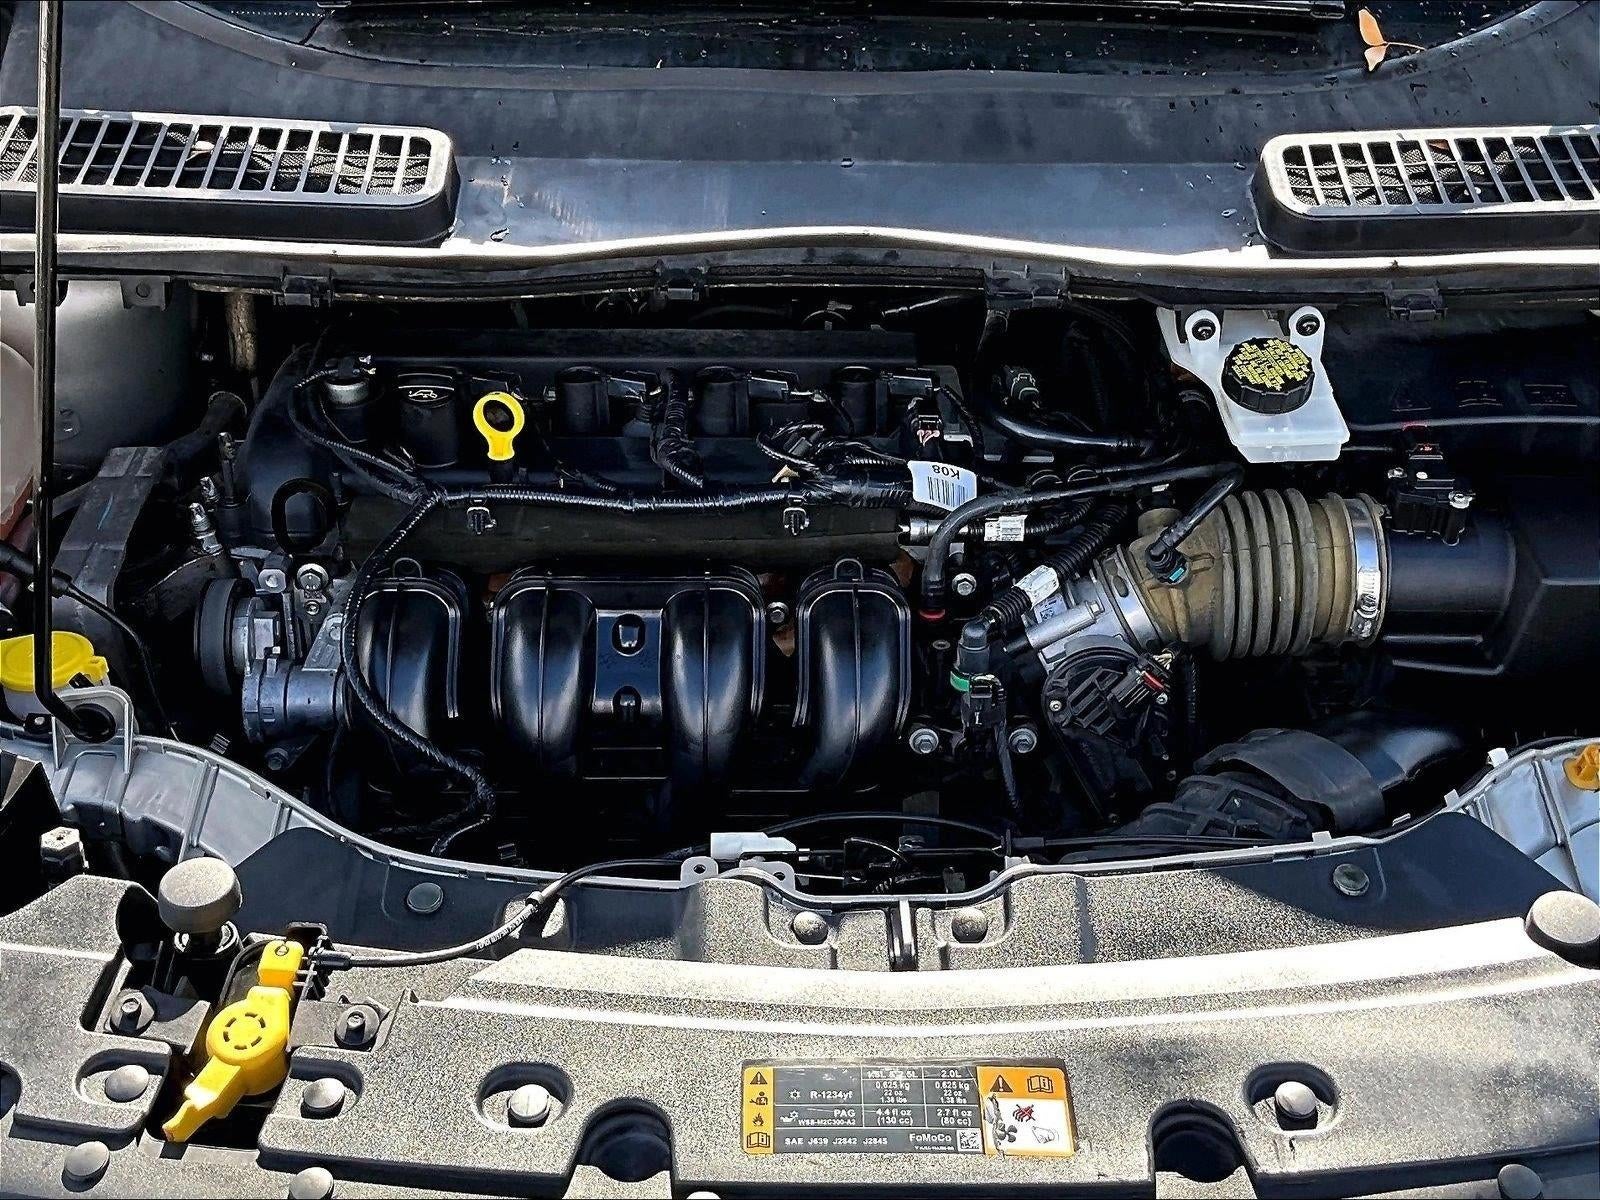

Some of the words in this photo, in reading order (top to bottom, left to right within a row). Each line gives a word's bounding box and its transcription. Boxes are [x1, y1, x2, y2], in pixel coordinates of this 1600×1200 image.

[932, 465, 960, 480] K08
[941, 1070, 962, 1078] 2.0L
[875, 1081, 897, 1089] 0.625
[900, 1081, 911, 1091] kg
[935, 1081, 957, 1089] 0.625
[959, 1081, 970, 1091] kg
[834, 1109, 856, 1117] PAG
[875, 1108, 889, 1116] 4.4
[937, 1108, 950, 1116] 2.7
[877, 1117, 897, 1126] (130
[899, 1117, 913, 1126] cc)
[941, 1117, 955, 1126] (80
[956, 1117, 972, 1126] cc)
[785, 1137, 804, 1145] SAE
[909, 1133, 952, 1142] FoMoCo
